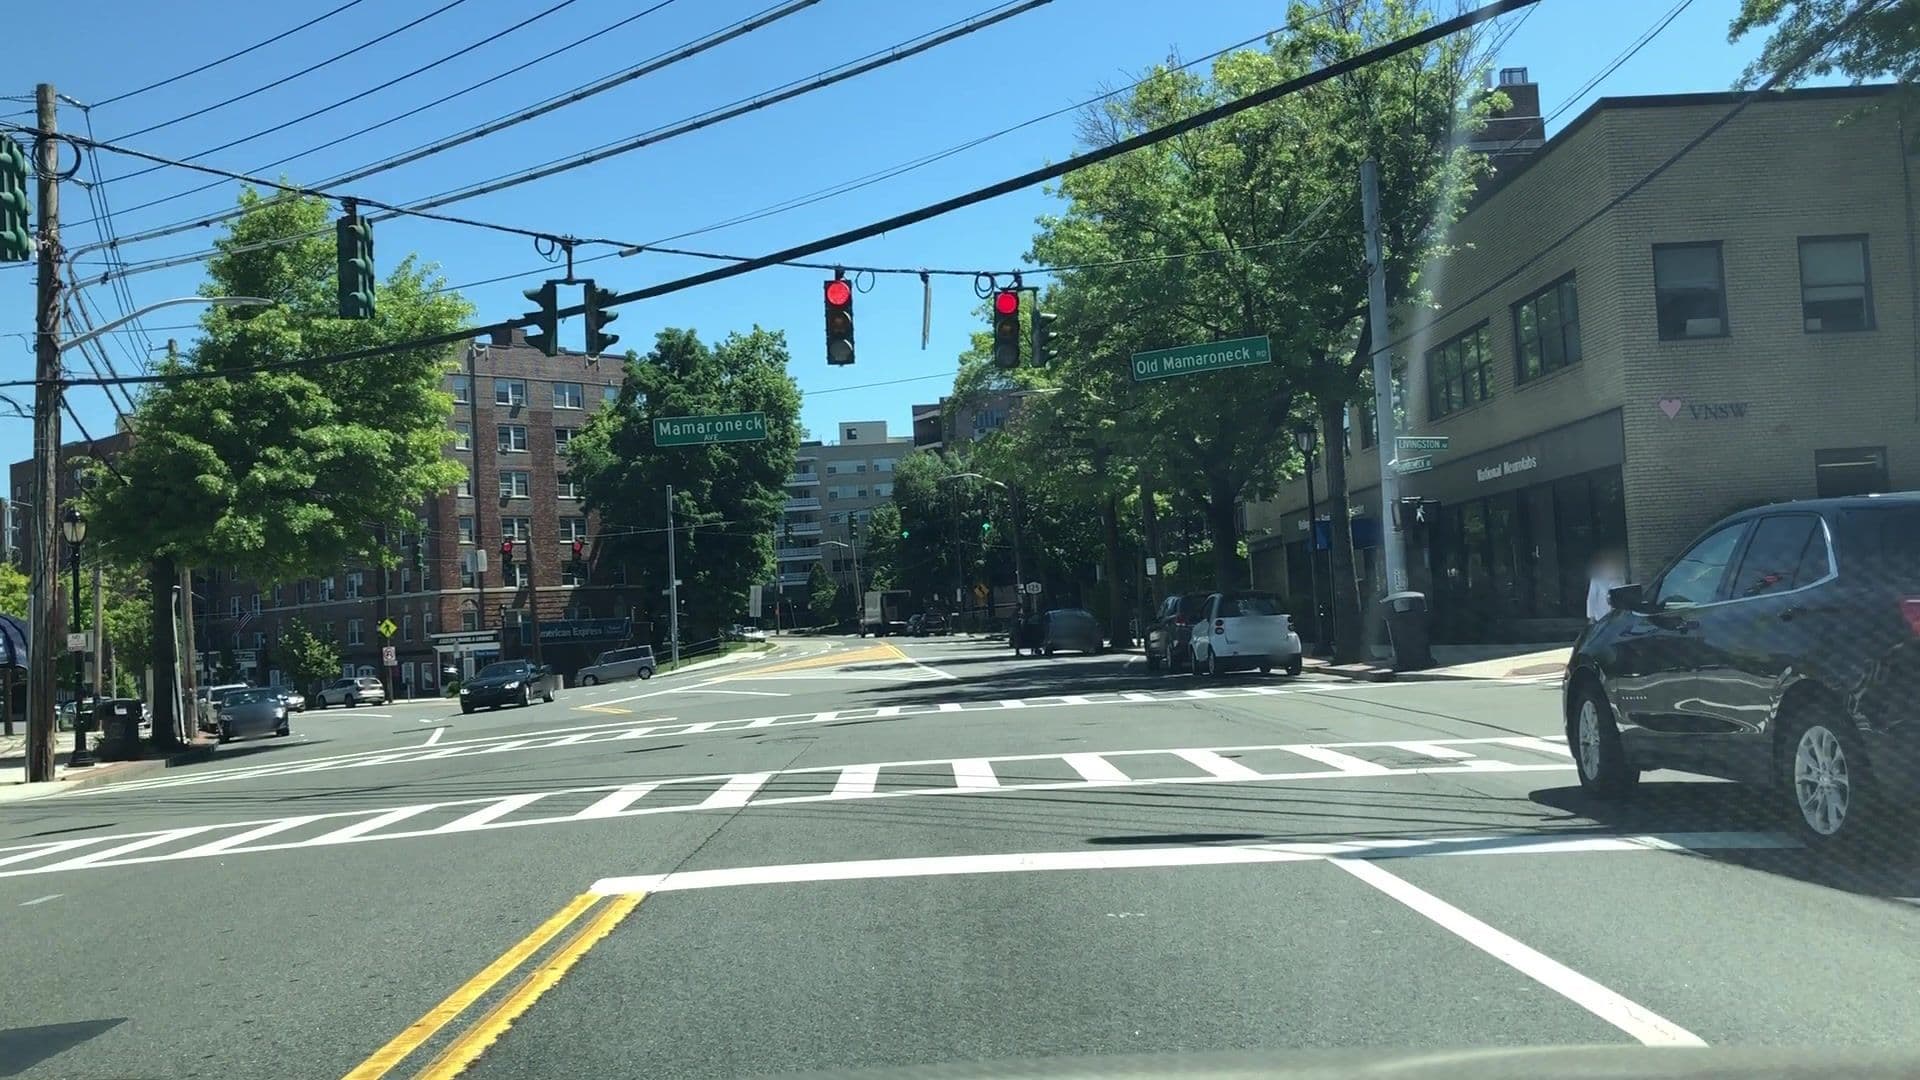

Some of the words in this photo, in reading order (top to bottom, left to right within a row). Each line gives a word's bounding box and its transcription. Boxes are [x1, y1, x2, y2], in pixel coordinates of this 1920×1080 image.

[1136, 359, 1158, 374] Old
[1163, 347, 1250, 370] Mamaroneck
[1256, 350, 1267, 358] RD
[1688, 402, 1748, 420] VNSW
[660, 416, 762, 436] Mamaroneck
[1398, 439, 1440, 449] LIVINGSTON
[538, 627, 571, 639] merican
